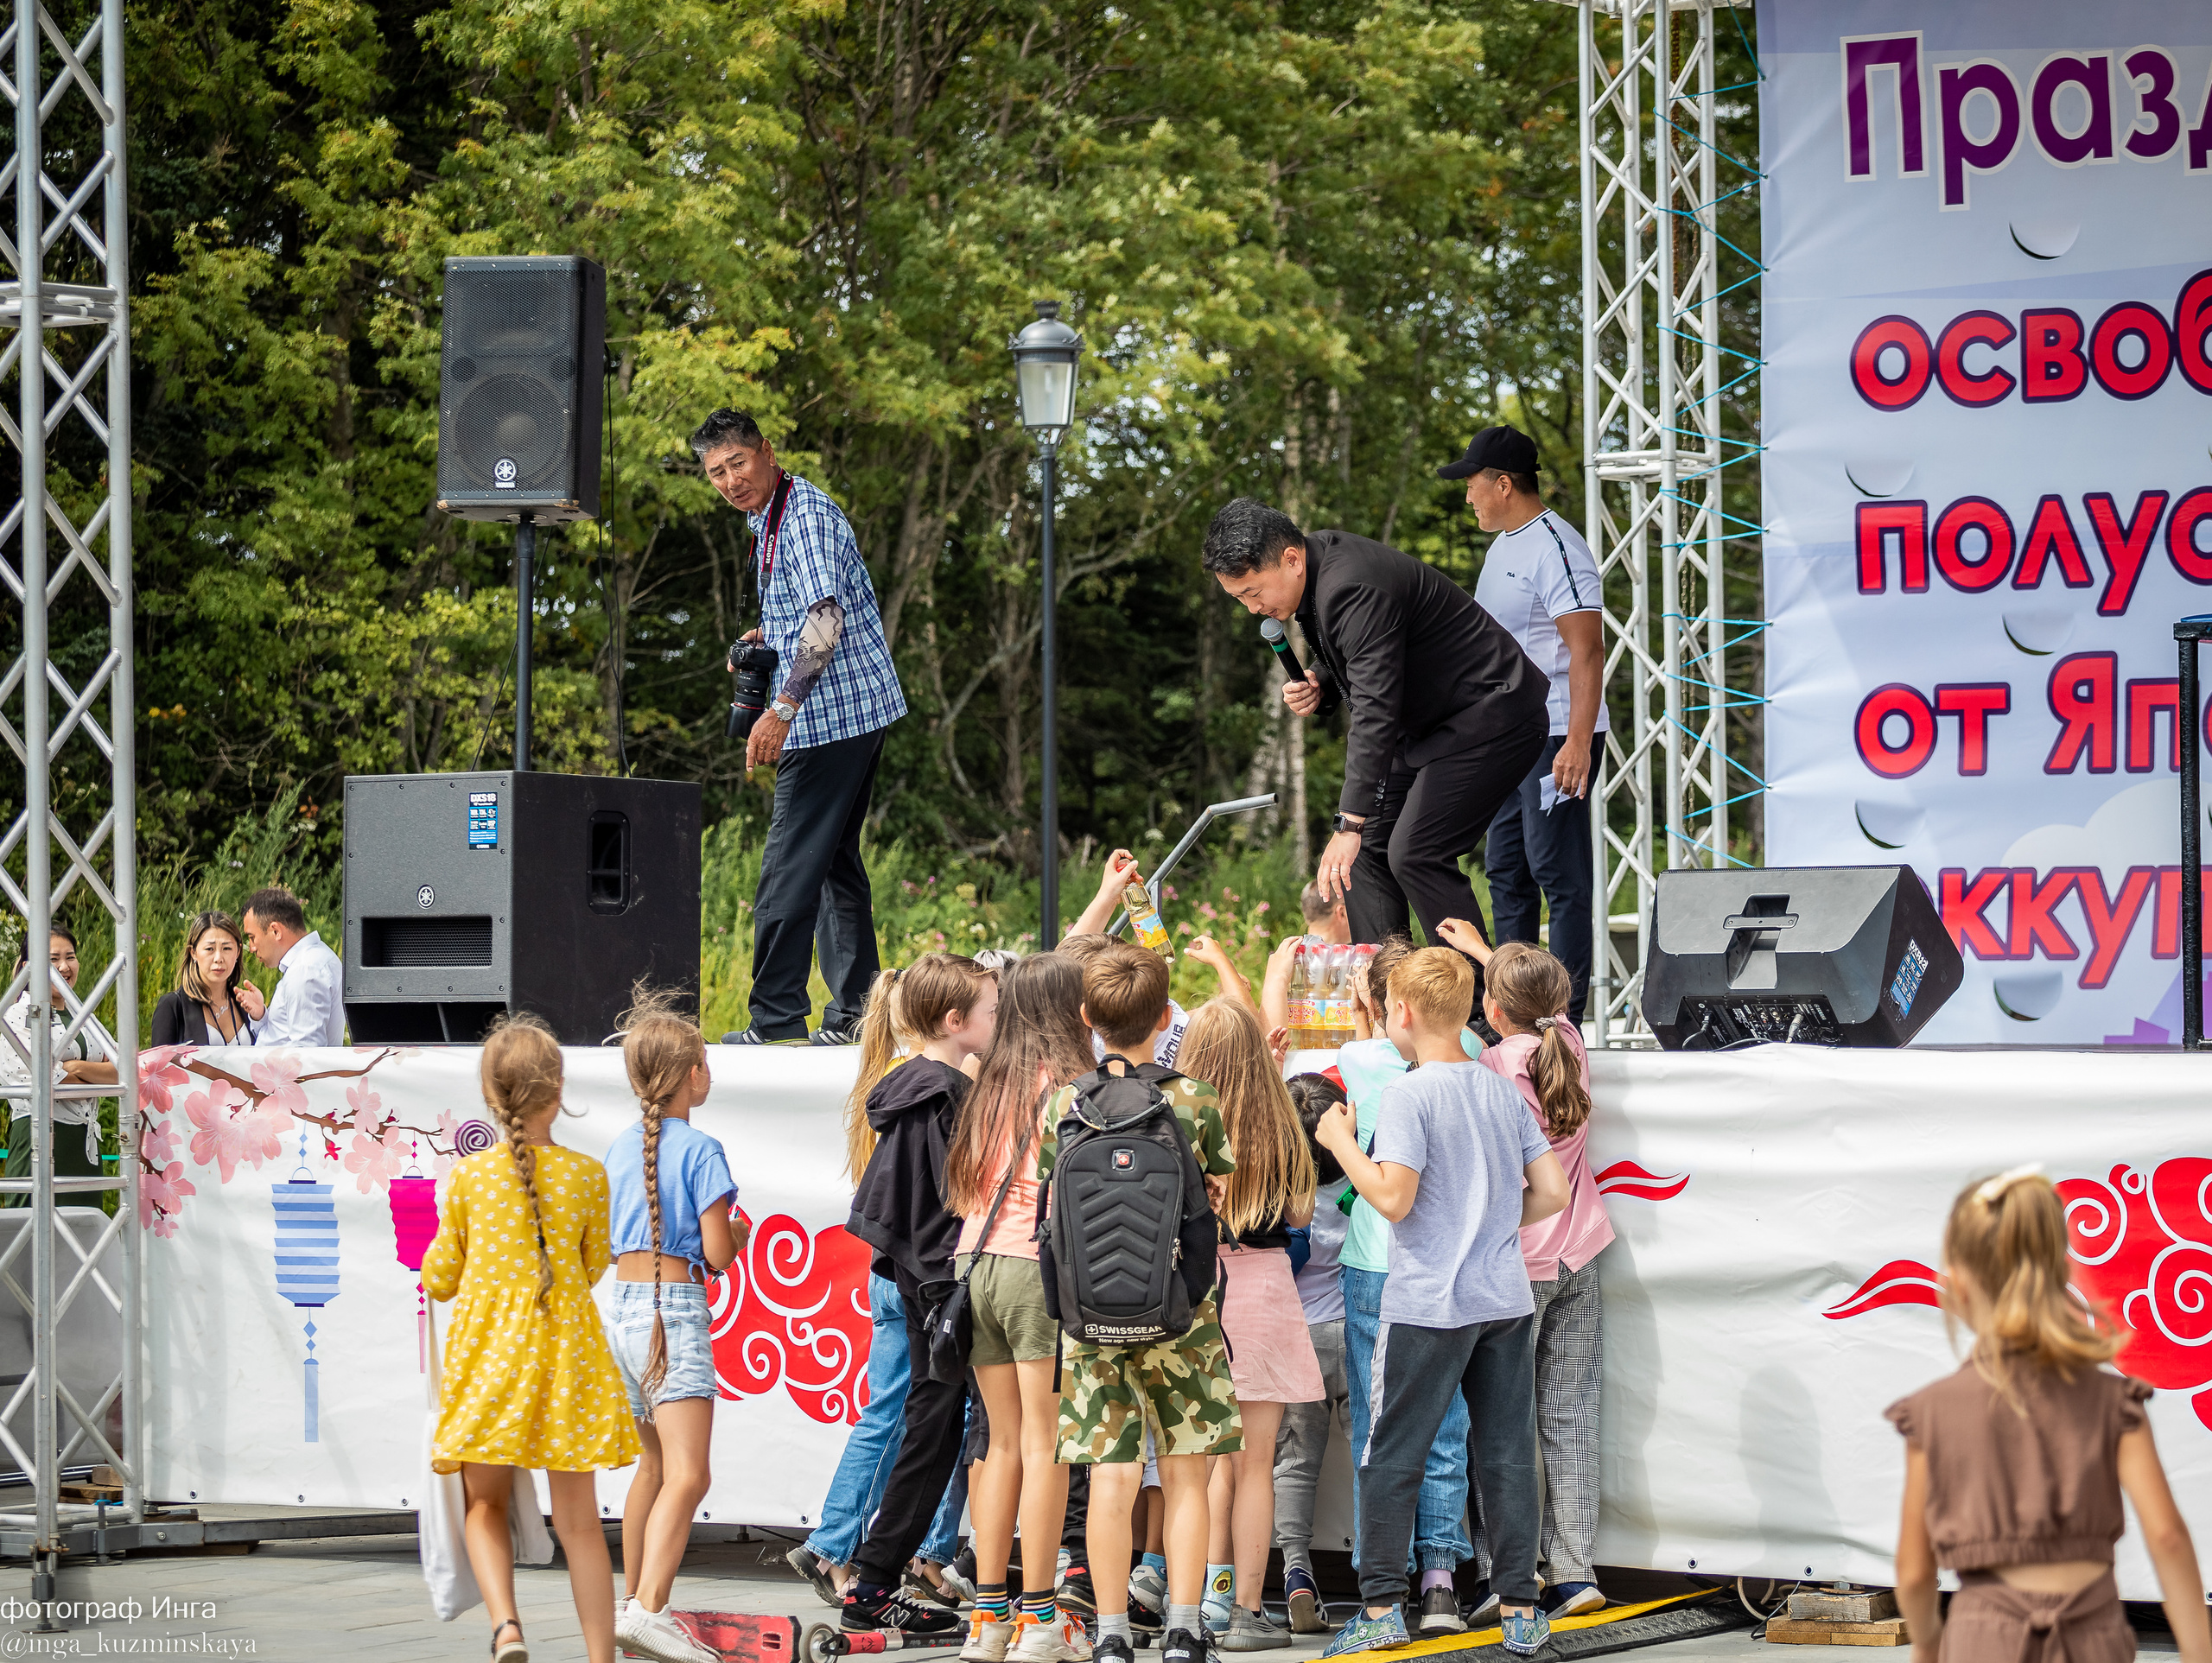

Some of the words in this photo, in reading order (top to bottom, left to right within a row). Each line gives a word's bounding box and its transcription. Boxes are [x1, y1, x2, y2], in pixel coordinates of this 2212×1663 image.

[765, 534, 775, 564] Canon
[1854, 682, 2011, 778] от
[2044, 651, 2212, 775] Яп
[470, 793, 497, 803] DXS18
[1917, 866, 2212, 989] ккуп
[1098, 1325, 1163, 1335] SWISSGEAR
